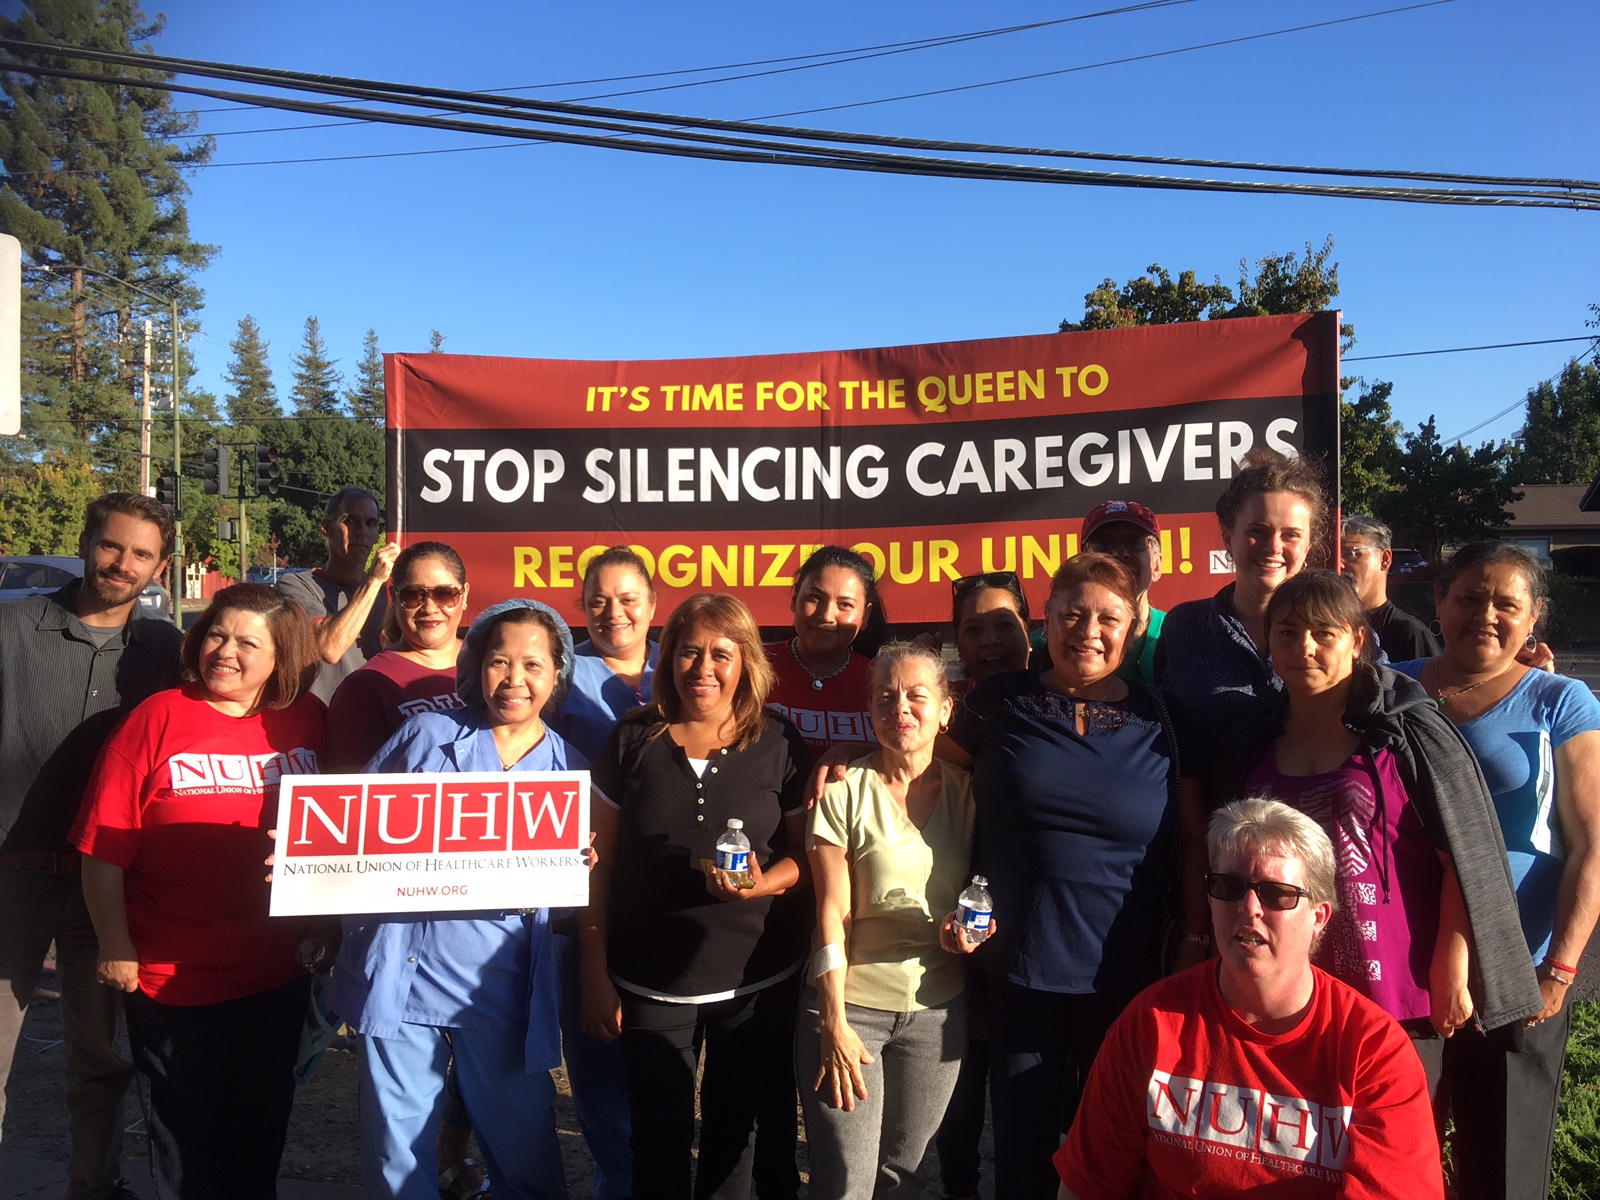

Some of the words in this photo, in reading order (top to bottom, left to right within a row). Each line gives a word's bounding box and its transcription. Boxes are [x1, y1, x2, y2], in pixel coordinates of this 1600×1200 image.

[586, 386, 650, 412] IT'S
[660, 383, 744, 411] TIME
[756, 381, 831, 411] FOR
[838, 378, 906, 410] THE
[917, 369, 1045, 413] QUEEN
[1056, 364, 1109, 398] TO
[420, 448, 565, 503] STOP
[582, 444, 889, 503] SILENCING
[906, 418, 1298, 496] CAREGIVERS
[849, 539, 962, 585] OUR
[172, 753, 316, 782] NUHW
[216, 785, 242, 795] UNION
[293, 790, 578, 845] NUHW
[283, 862, 353, 876] NATIONAL
[356, 860, 402, 874] UNION
[405, 860, 422, 871] OF
[425, 857, 512, 872] HEALTHCARE
[515, 855, 580, 868] WORKERS
[397, 884, 468, 897] NUHW.ORG
[1194, 1141, 1233, 1158] UNION
[1235, 1150, 1250, 1161] OF
[1250, 1152, 1324, 1178] HEALTHCARE
